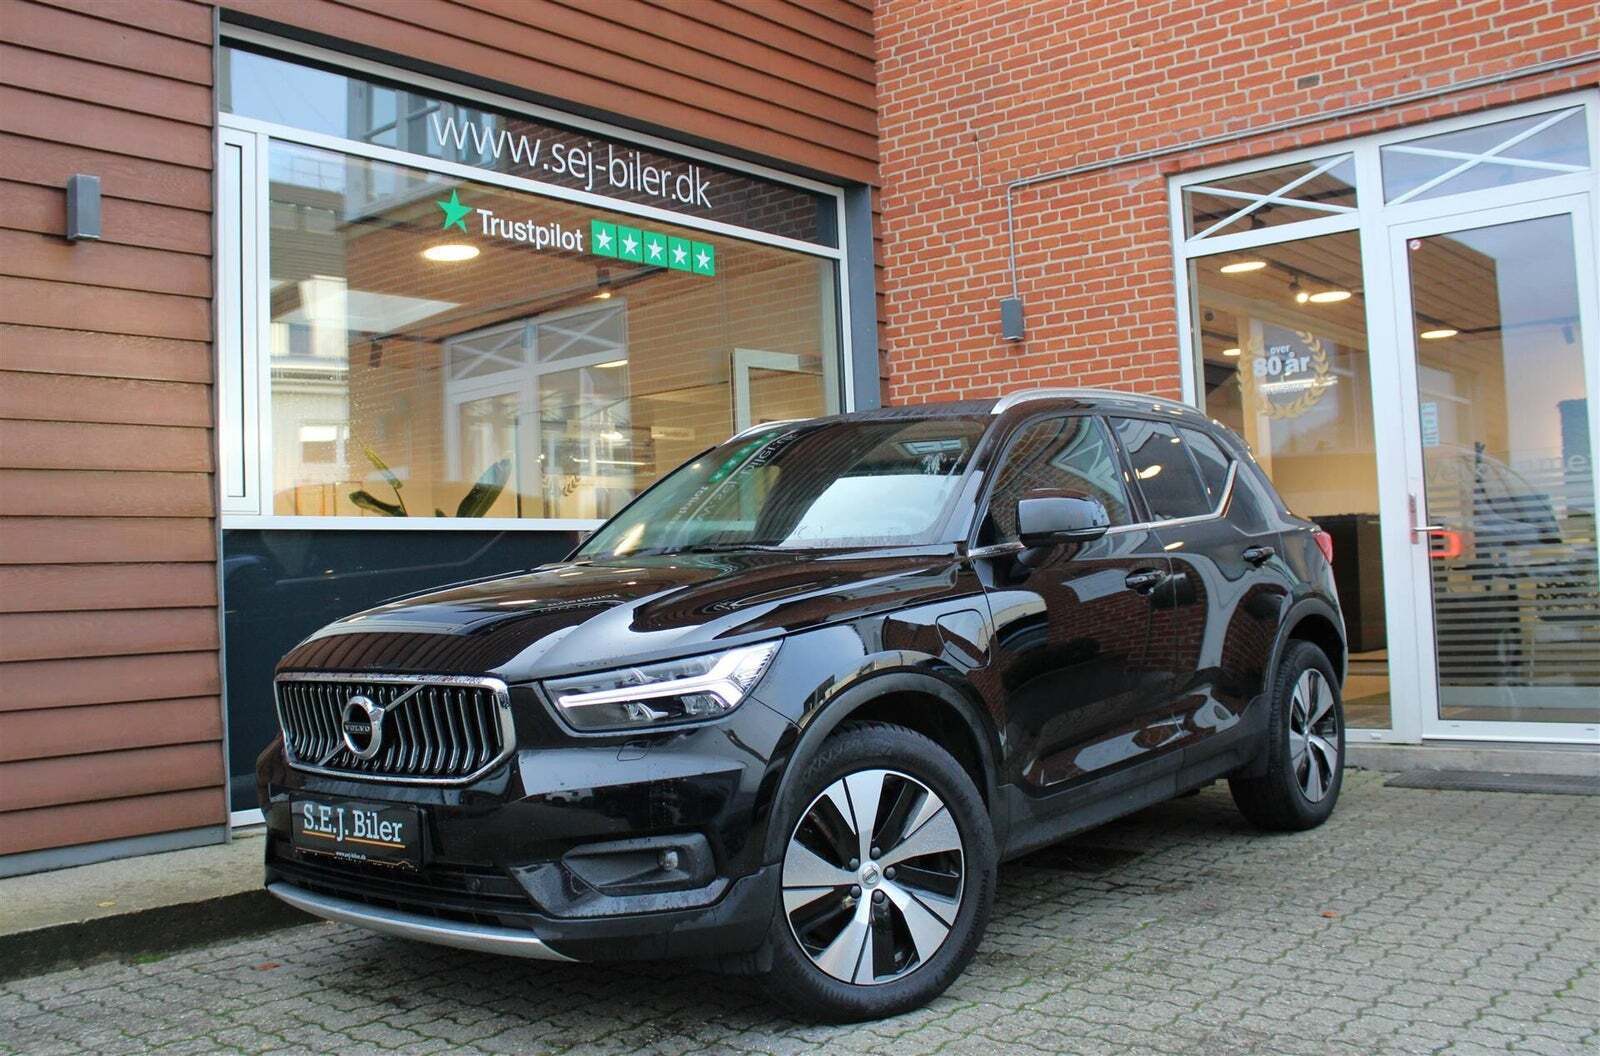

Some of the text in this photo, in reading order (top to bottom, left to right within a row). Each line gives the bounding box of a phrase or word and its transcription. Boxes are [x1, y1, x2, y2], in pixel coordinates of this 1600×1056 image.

[432, 112, 713, 209] www.sej-biler.dk
[476, 207, 583, 252] Trustpilot
[1253, 351, 1311, 377] 80 år
[1270, 344, 1291, 354] over
[344, 723, 371, 732] VOLVO
[303, 803, 403, 843] S.E.J. Biler
